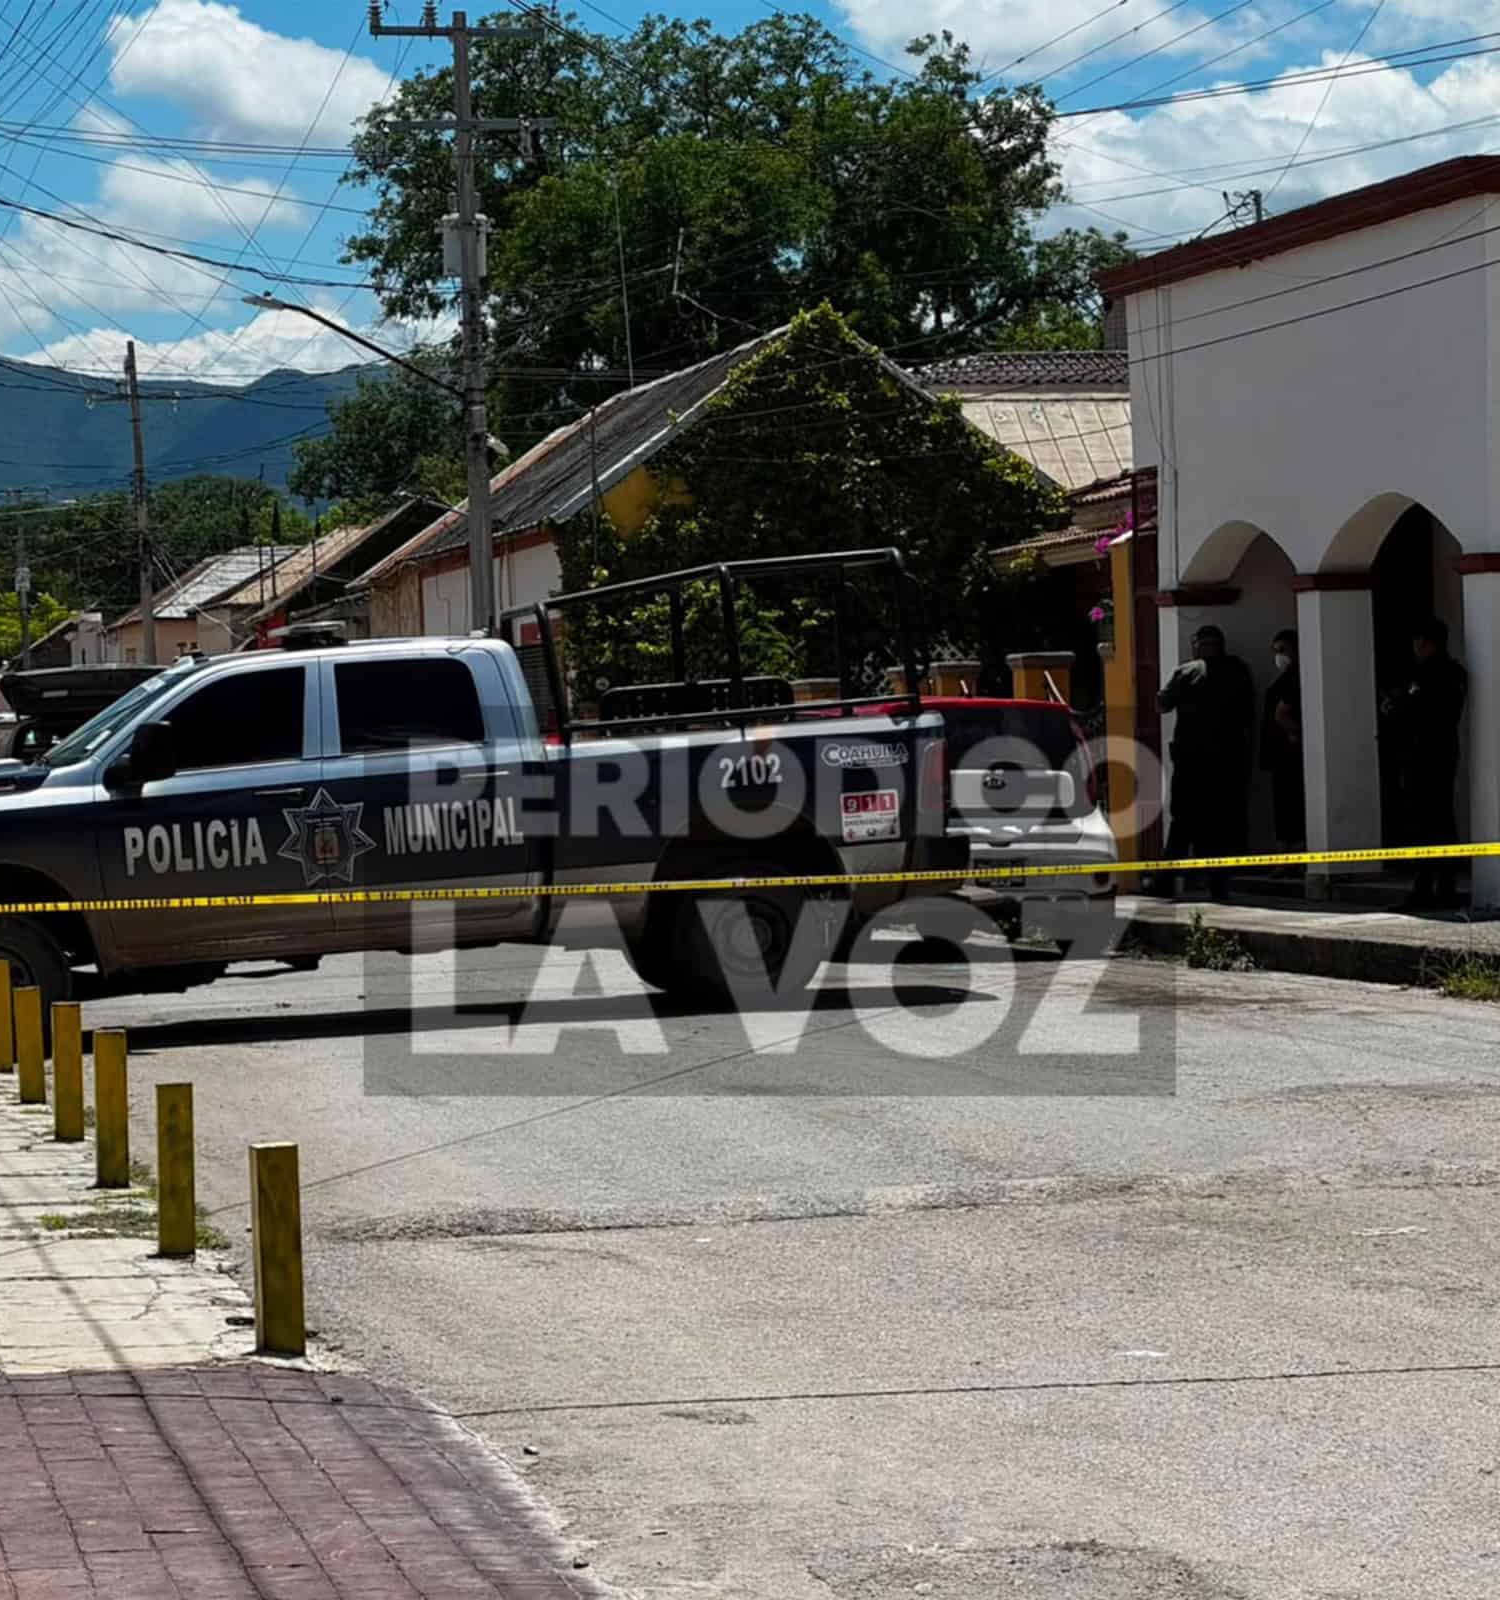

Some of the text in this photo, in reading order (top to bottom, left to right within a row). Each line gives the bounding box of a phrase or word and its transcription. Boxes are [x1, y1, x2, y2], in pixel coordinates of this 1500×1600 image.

[718, 752, 784, 789] 2102
[846, 794, 893, 812] 911
[383, 796, 525, 855] MUNICIPAL
